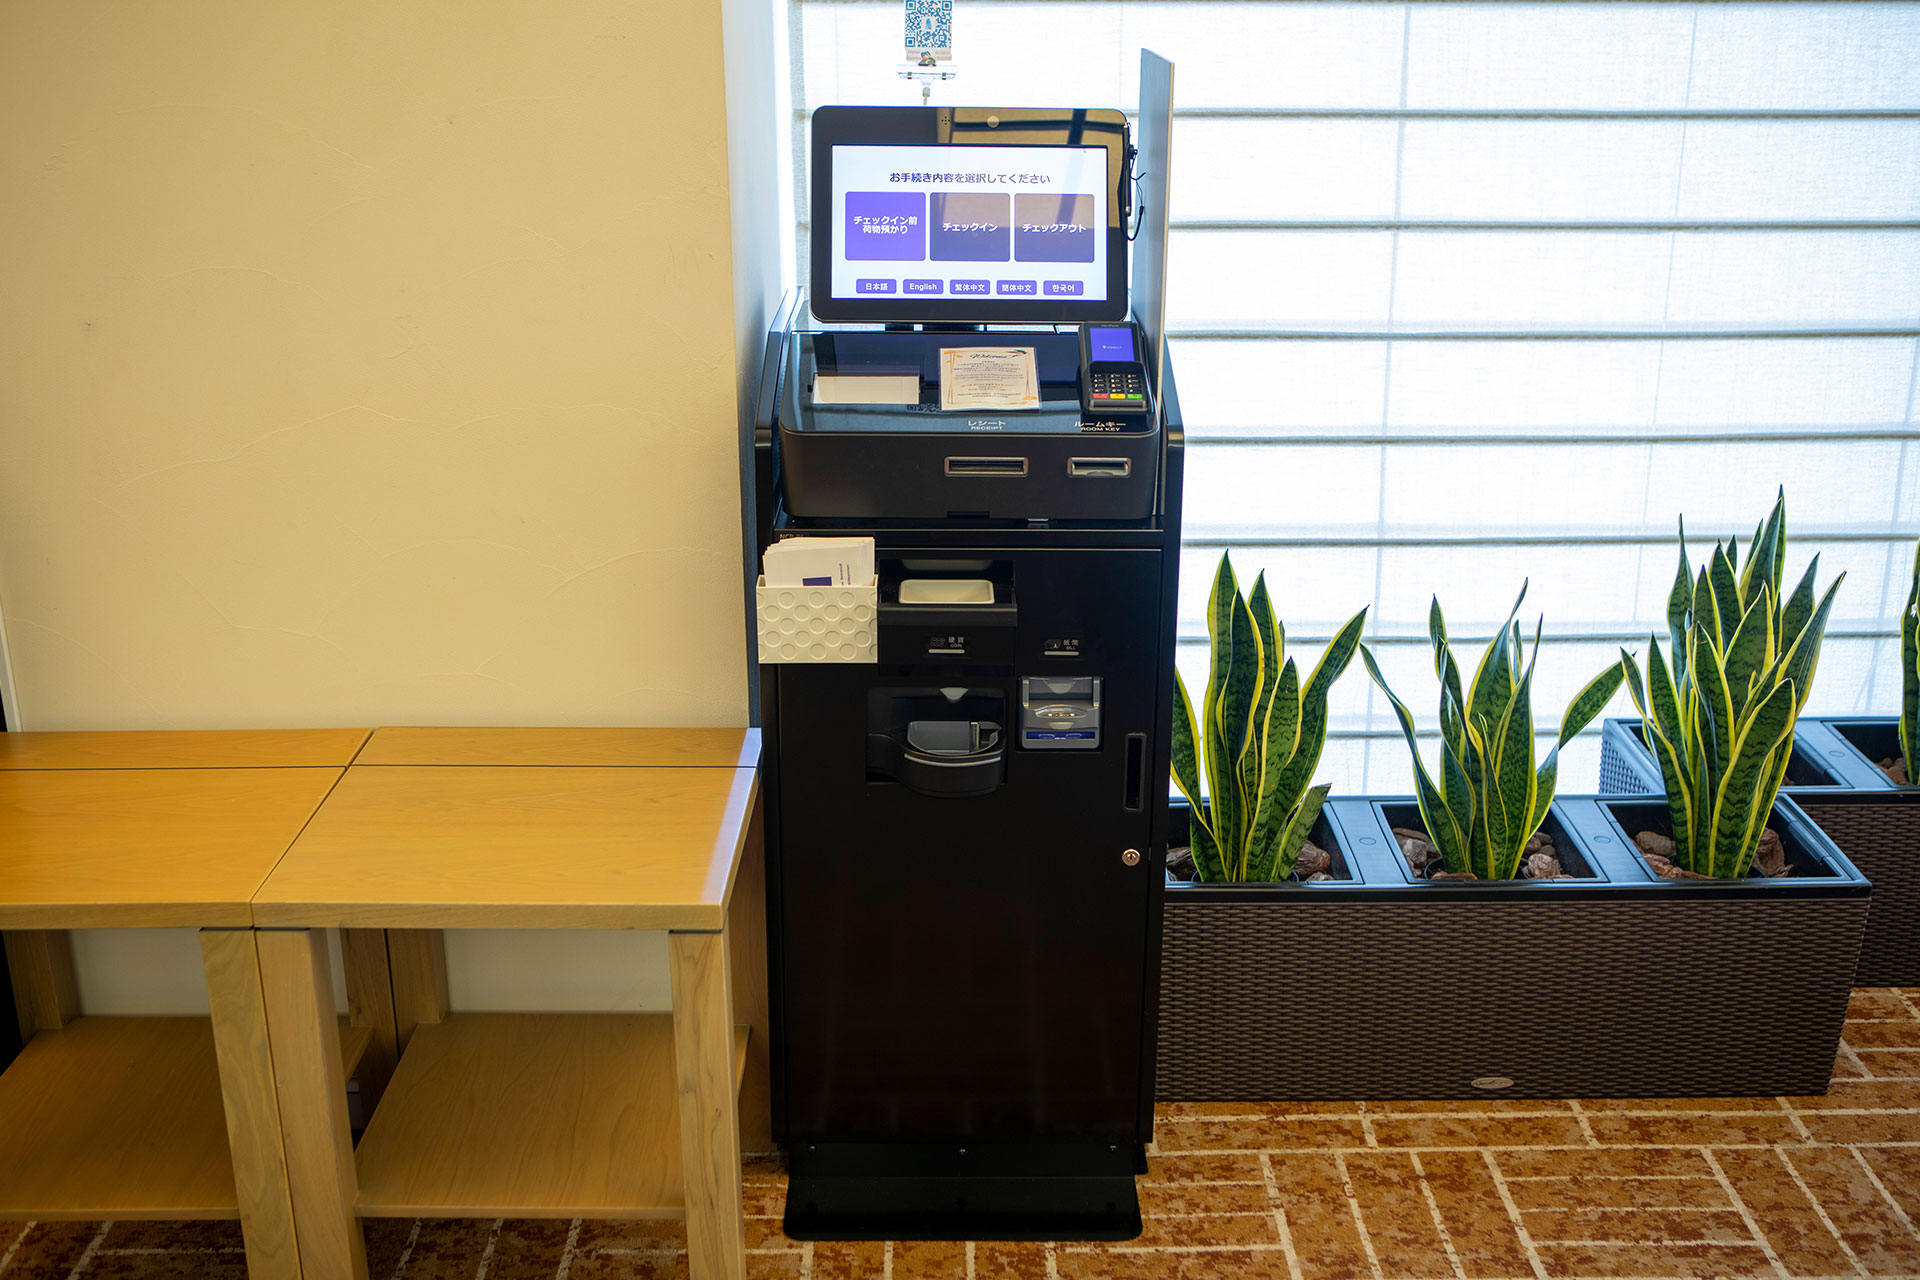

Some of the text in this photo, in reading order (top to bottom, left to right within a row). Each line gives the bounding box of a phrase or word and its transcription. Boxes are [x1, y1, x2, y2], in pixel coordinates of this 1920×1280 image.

[889, 172, 1051, 185] お手続き内容を選択してください
[853, 215, 918, 226] チェックイン前
[862, 225, 908, 234] 荷物預かり
[942, 222, 998, 232] チェックイン
[1022, 223, 1087, 233] チェックアウト
[865, 282, 888, 291] 日本語
[909, 282, 938, 292] English
[1052, 284, 1075, 293] 한국어
